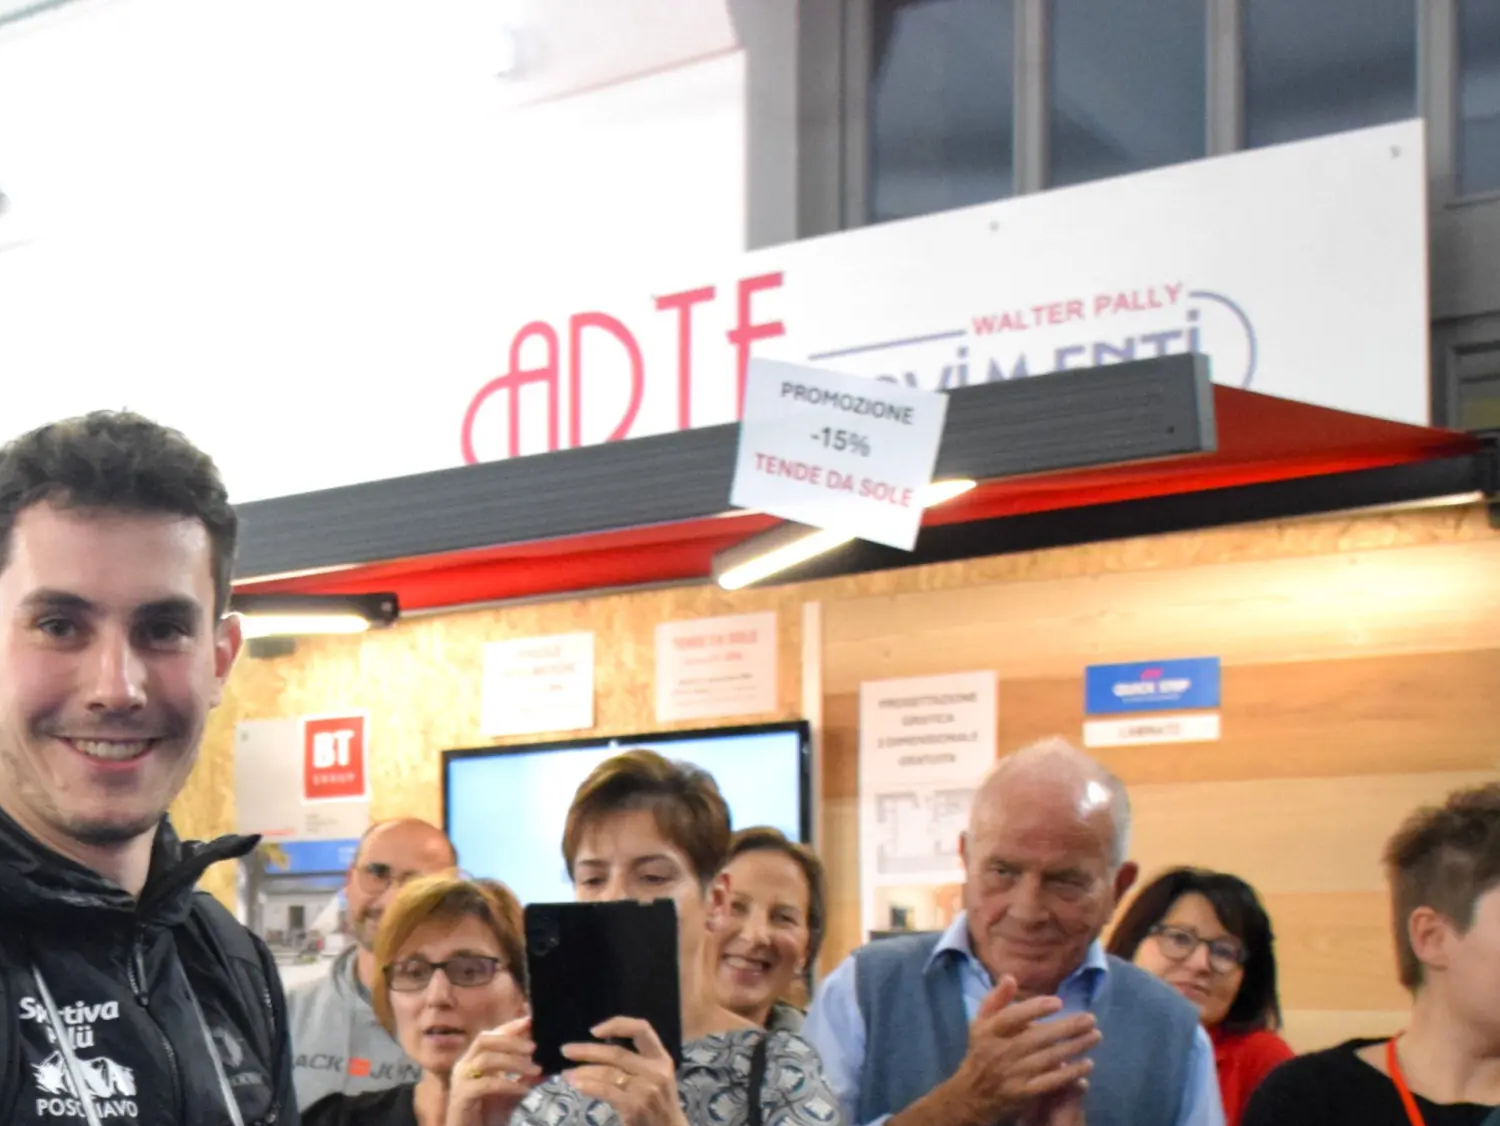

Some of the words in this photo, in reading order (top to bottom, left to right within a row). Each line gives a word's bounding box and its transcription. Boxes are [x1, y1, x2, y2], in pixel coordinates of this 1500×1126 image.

[972, 299, 1085, 337] WALTER
[1094, 282, 1184, 317] PALLY
[780, 381, 915, 425] PROMOZIONE
[810, 427, 871, 458] -15%
[755, 453, 822, 486] TENDE
[826, 470, 855, 492] DA
[859, 478, 913, 508] SOLE
[312, 729, 356, 769] BT
[294, 1053, 344, 1073] ACK
